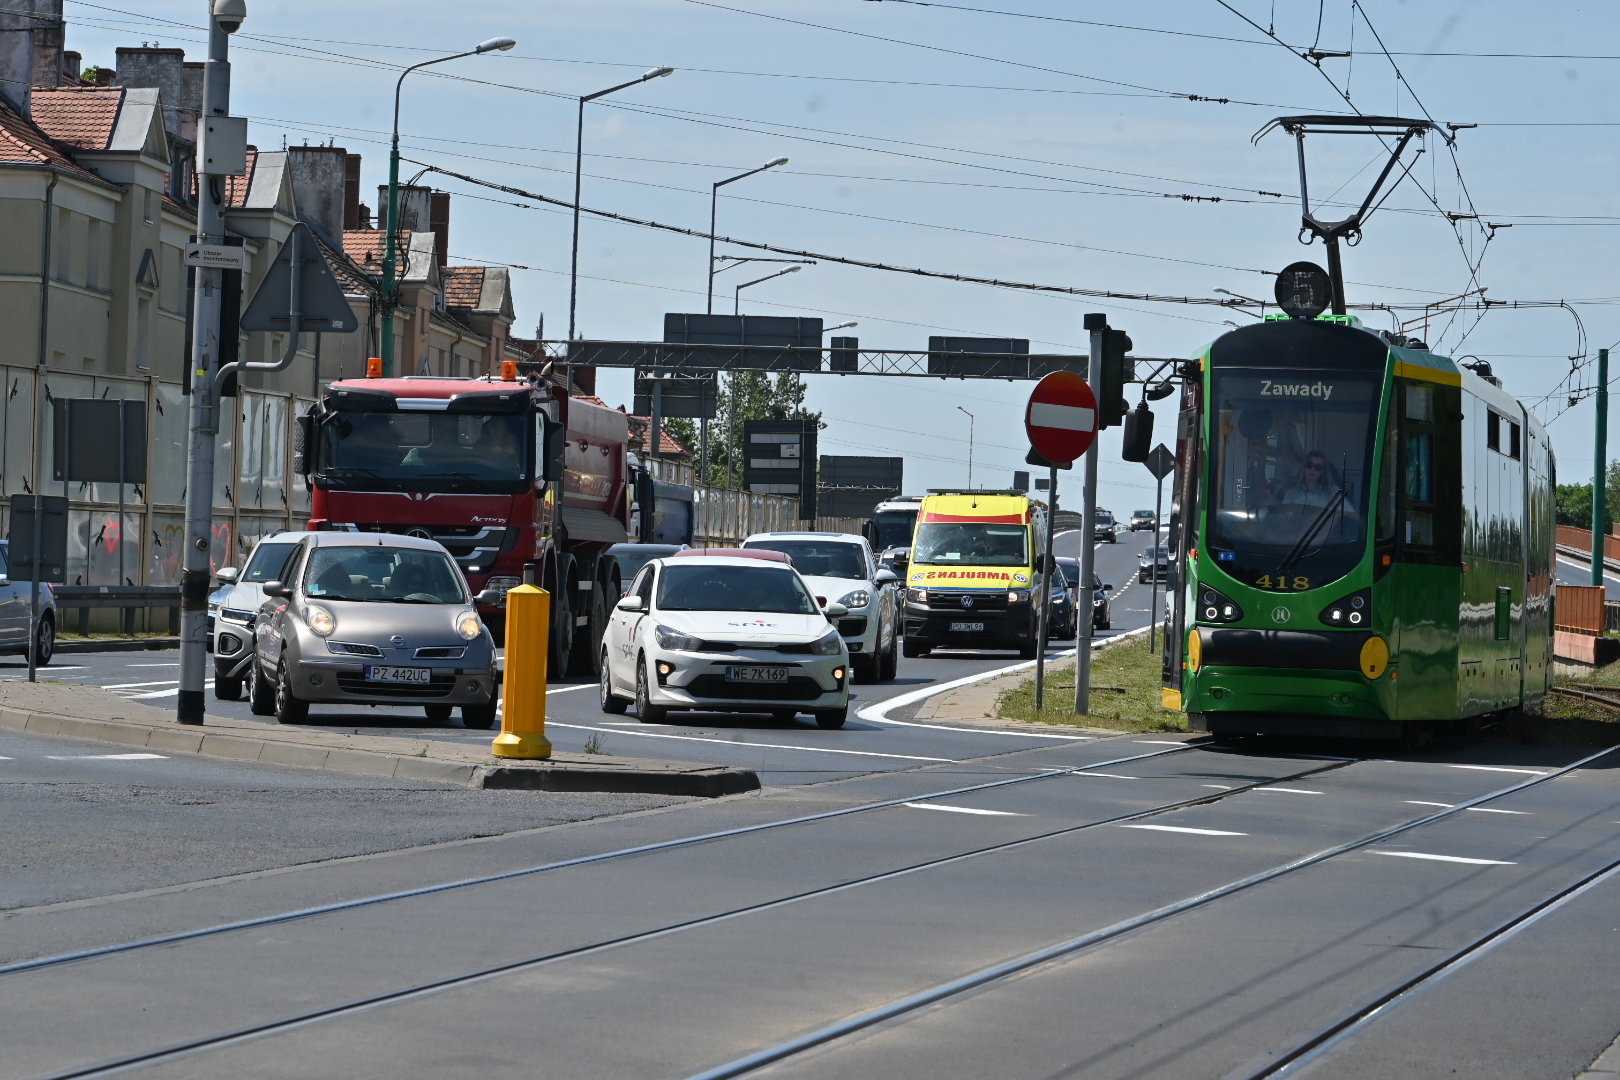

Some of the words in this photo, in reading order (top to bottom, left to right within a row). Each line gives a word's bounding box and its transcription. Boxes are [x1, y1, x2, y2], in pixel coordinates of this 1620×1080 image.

[1293, 271, 1314, 309] 5
[1260, 380, 1334, 400] Zawady
[1255, 574, 1310, 590] 418
[372, 668, 388, 680] PZ
[392, 668, 428, 681] 442UC
[733, 668, 747, 680] WE
[751, 668, 785, 680] 7K169
